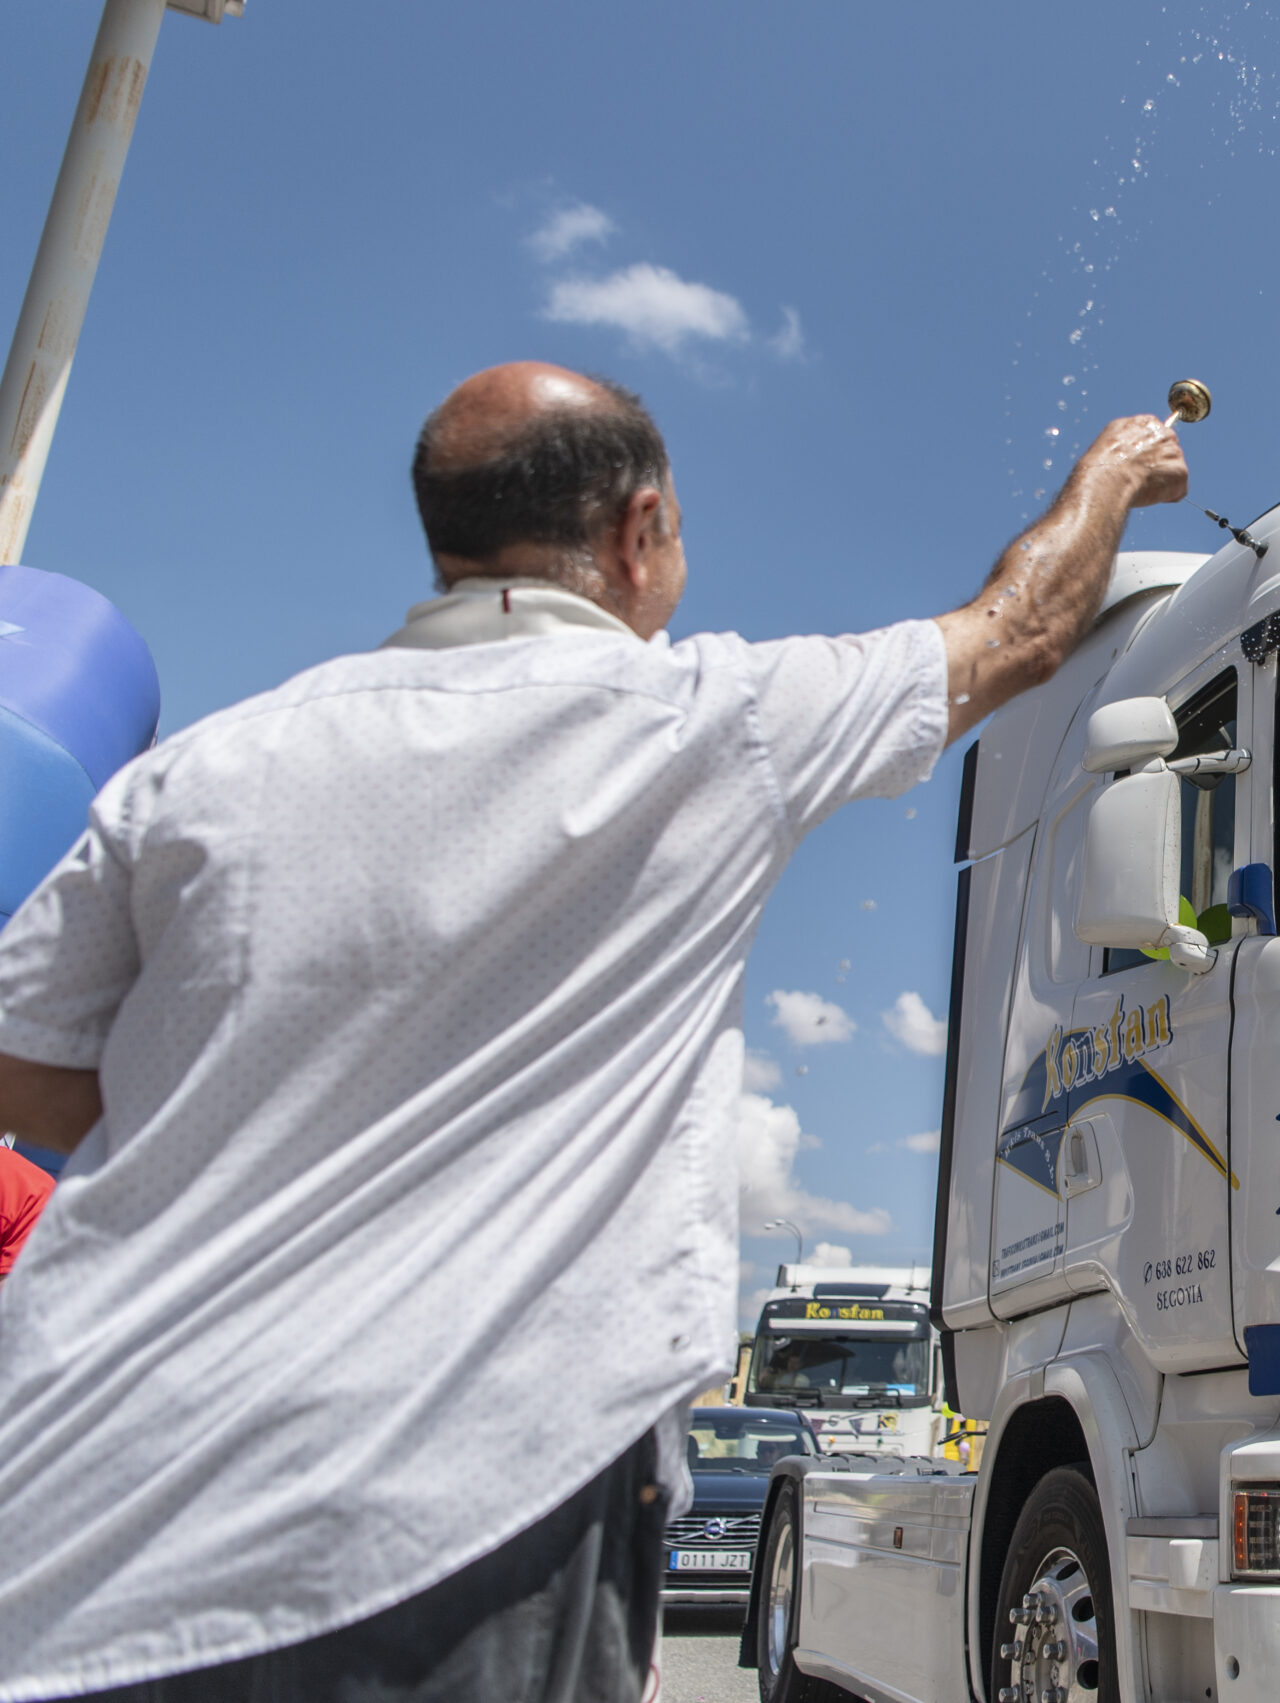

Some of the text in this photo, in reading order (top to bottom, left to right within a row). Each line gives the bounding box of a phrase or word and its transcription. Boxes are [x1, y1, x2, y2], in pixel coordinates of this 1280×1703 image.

[1041, 993, 1173, 1114] Konstan
[1155, 1249, 1216, 1280] 638 622 862
[1156, 1284, 1203, 1311] SEGOVIA
[681, 1554, 747, 1567] 0111 JZT
